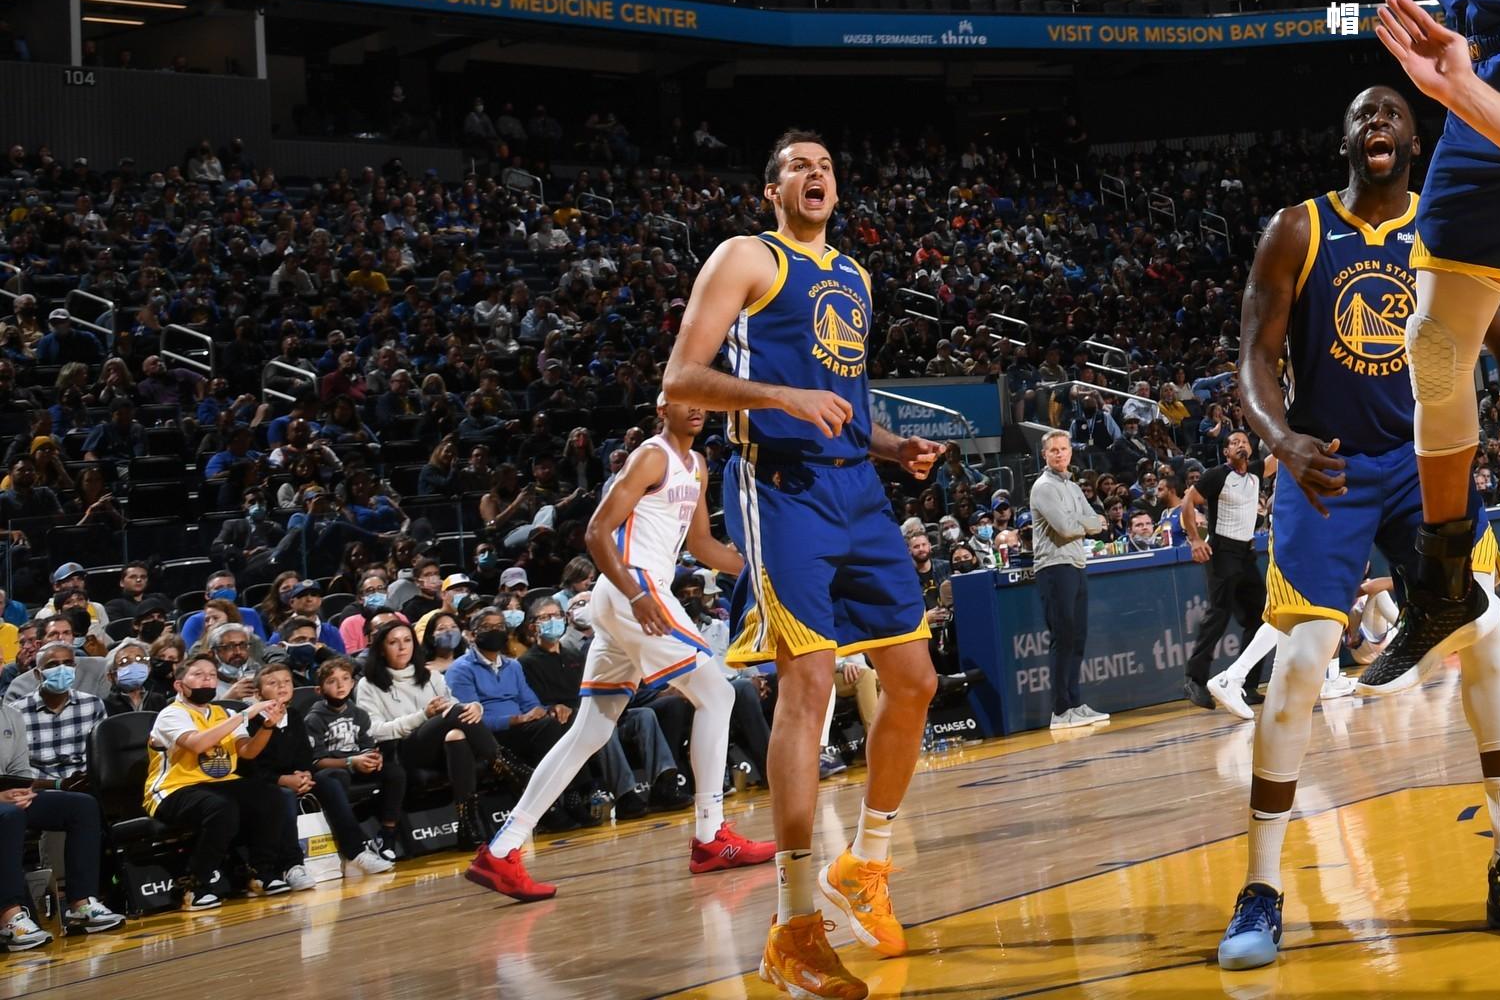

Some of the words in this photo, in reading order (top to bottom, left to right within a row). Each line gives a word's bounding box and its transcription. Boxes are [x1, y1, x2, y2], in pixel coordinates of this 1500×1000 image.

[621, 3, 697, 30] CENTER
[842, 33, 873, 46] KAISER
[941, 29, 987, 47] thrive
[1046, 23, 1094, 43] VISIT
[1099, 24, 1139, 43] OUR
[1144, 22, 1224, 44] MISSION
[1229, 20, 1267, 41] BAY
[64, 70, 96, 86] 104
[1333, 260, 1380, 288] GOLDEN
[808, 279, 840, 298] GOLDEN
[1381, 293, 1410, 319] 23
[851, 308, 863, 328] 8
[933, 720, 967, 734] CHASE
